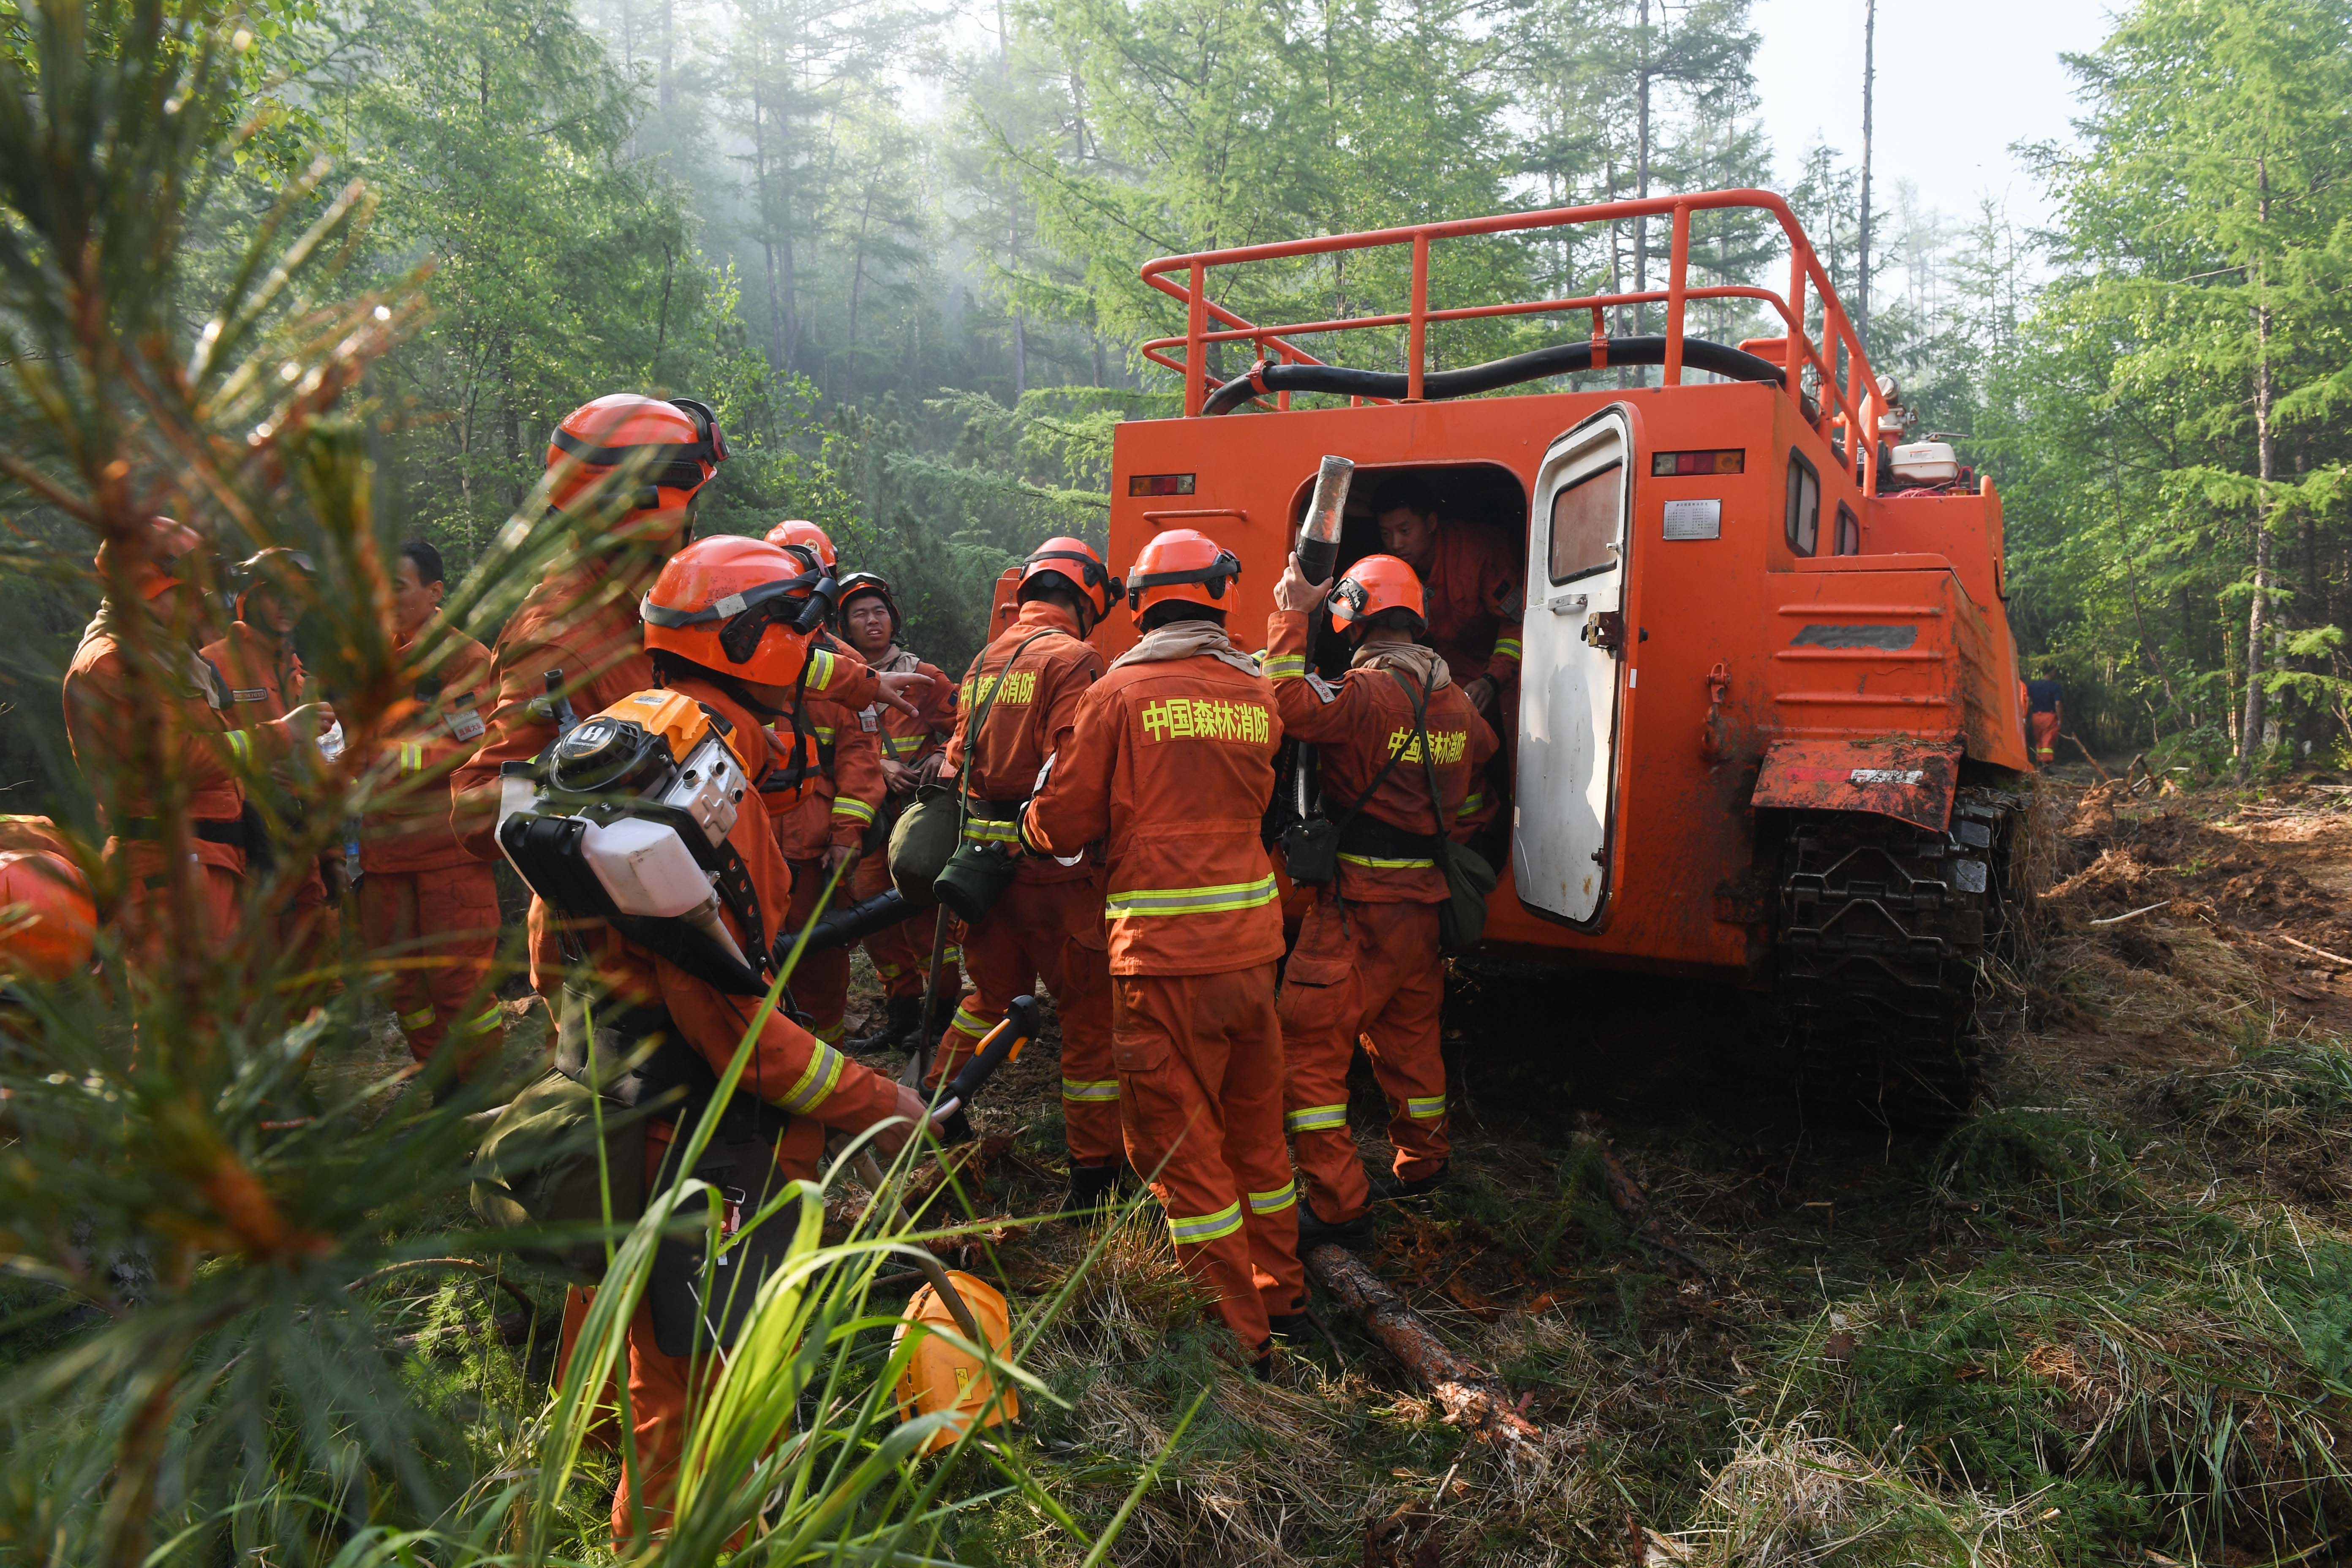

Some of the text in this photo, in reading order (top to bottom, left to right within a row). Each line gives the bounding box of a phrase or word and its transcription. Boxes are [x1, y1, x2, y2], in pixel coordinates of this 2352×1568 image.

[1141, 699, 1269, 744] 中国森林消防
